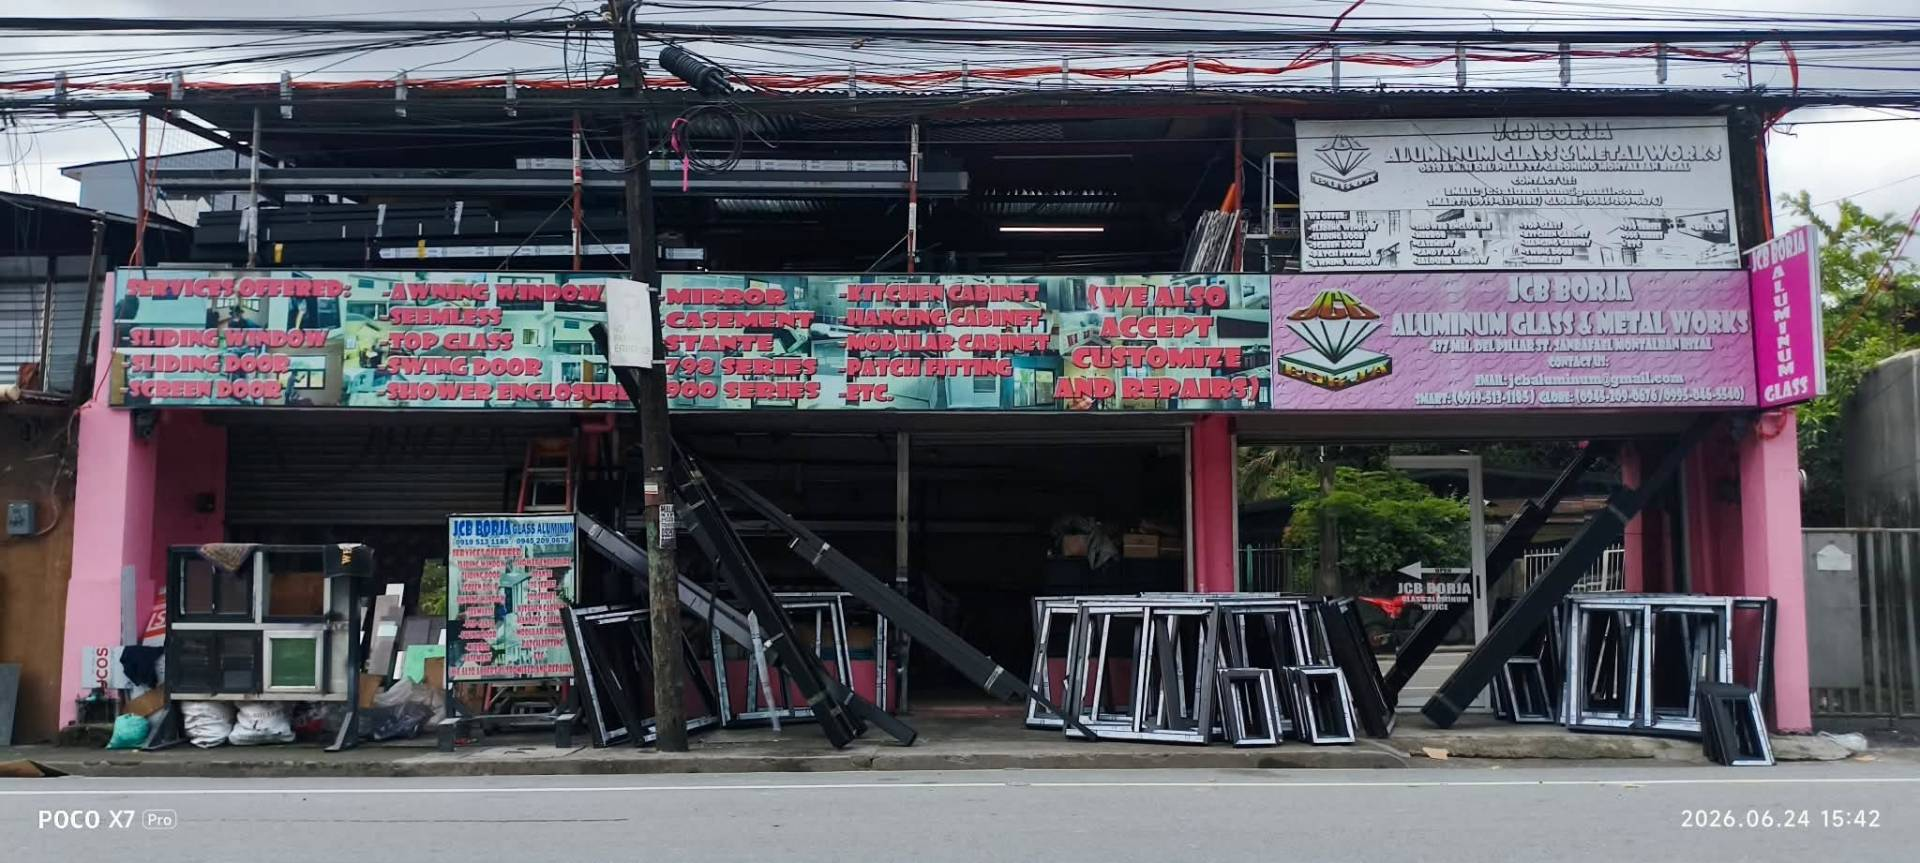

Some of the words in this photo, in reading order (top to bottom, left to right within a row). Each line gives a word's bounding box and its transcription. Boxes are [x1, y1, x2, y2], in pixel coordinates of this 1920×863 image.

[1537, 121, 1613, 141] BORJA
[1384, 145, 1496, 163] ALUMINUM
[1497, 144, 1558, 162] GLASS
[1560, 144, 1575, 162] &
[1576, 143, 1644, 162] METAL
[1645, 143, 1722, 161] WORKS
[1770, 230, 1806, 266] BORJA
[126, 278, 235, 298] SERVICES
[238, 278, 352, 299] OFFERED:
[495, 282, 606, 303] WINDOW
[946, 283, 1041, 303] CABINET
[1152, 284, 1228, 309] ALSO
[1508, 273, 1551, 303] JCB
[1554, 273, 1634, 303] BORJA
[949, 308, 1042, 328] CABINET
[1100, 315, 1215, 340] ACCEPT
[1391, 311, 1508, 338] ALUMINUM
[1510, 310, 1577, 337] GLASS
[1578, 310, 1594, 336] &
[1596, 309, 1668, 336] METAL
[1669, 308, 1749, 335] WORKS
[1772, 265, 1795, 378] ALUMINUM
[224, 327, 329, 348] WINDOW
[442, 332, 514, 352] GLASS
[957, 333, 1051, 353] CABINET
[223, 353, 291, 374] DOOR
[472, 356, 544, 378] DOOR
[720, 356, 819, 376] SERIES
[924, 357, 1014, 378] FITTING
[1071, 345, 1244, 370] CUSTOMIZE
[1549, 355, 1592, 369] CONTACT
[216, 379, 283, 399] DOOR
[723, 379, 822, 399] SERIES
[1053, 376, 1117, 401] AND
[1119, 376, 1261, 402] REPAIRS)
[1475, 374, 1508, 388] EMAIL:
[1764, 376, 1809, 403] GLASS
[453, 520, 474, 537] JCB
[475, 519, 512, 538] BORJA
[512, 523, 536, 535] GLASS
[537, 522, 574, 535] ALUMINUM
[1397, 582, 1423, 595] JCB
[1426, 582, 1472, 595] BORJA
